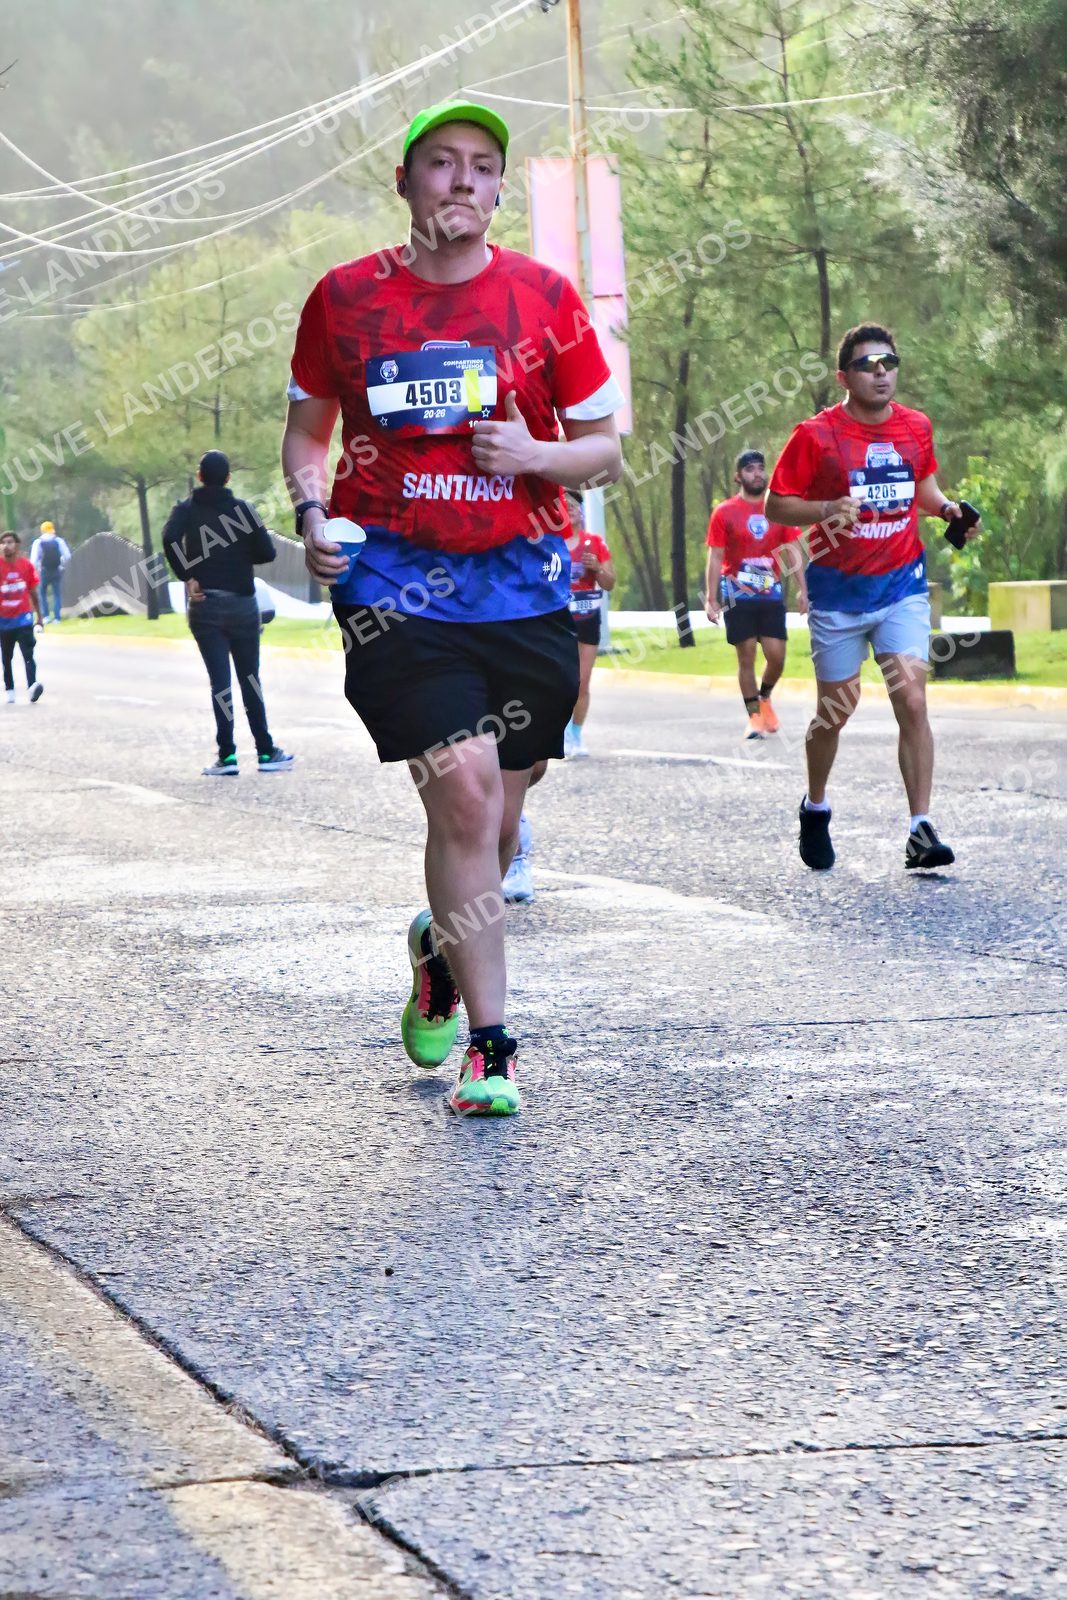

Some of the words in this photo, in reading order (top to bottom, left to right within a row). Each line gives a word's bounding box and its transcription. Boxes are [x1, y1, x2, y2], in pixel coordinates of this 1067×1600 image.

[405, 380, 462, 406] 4503
[402, 472, 515, 501] SANTIAGO
[867, 484, 897, 499] 4205
